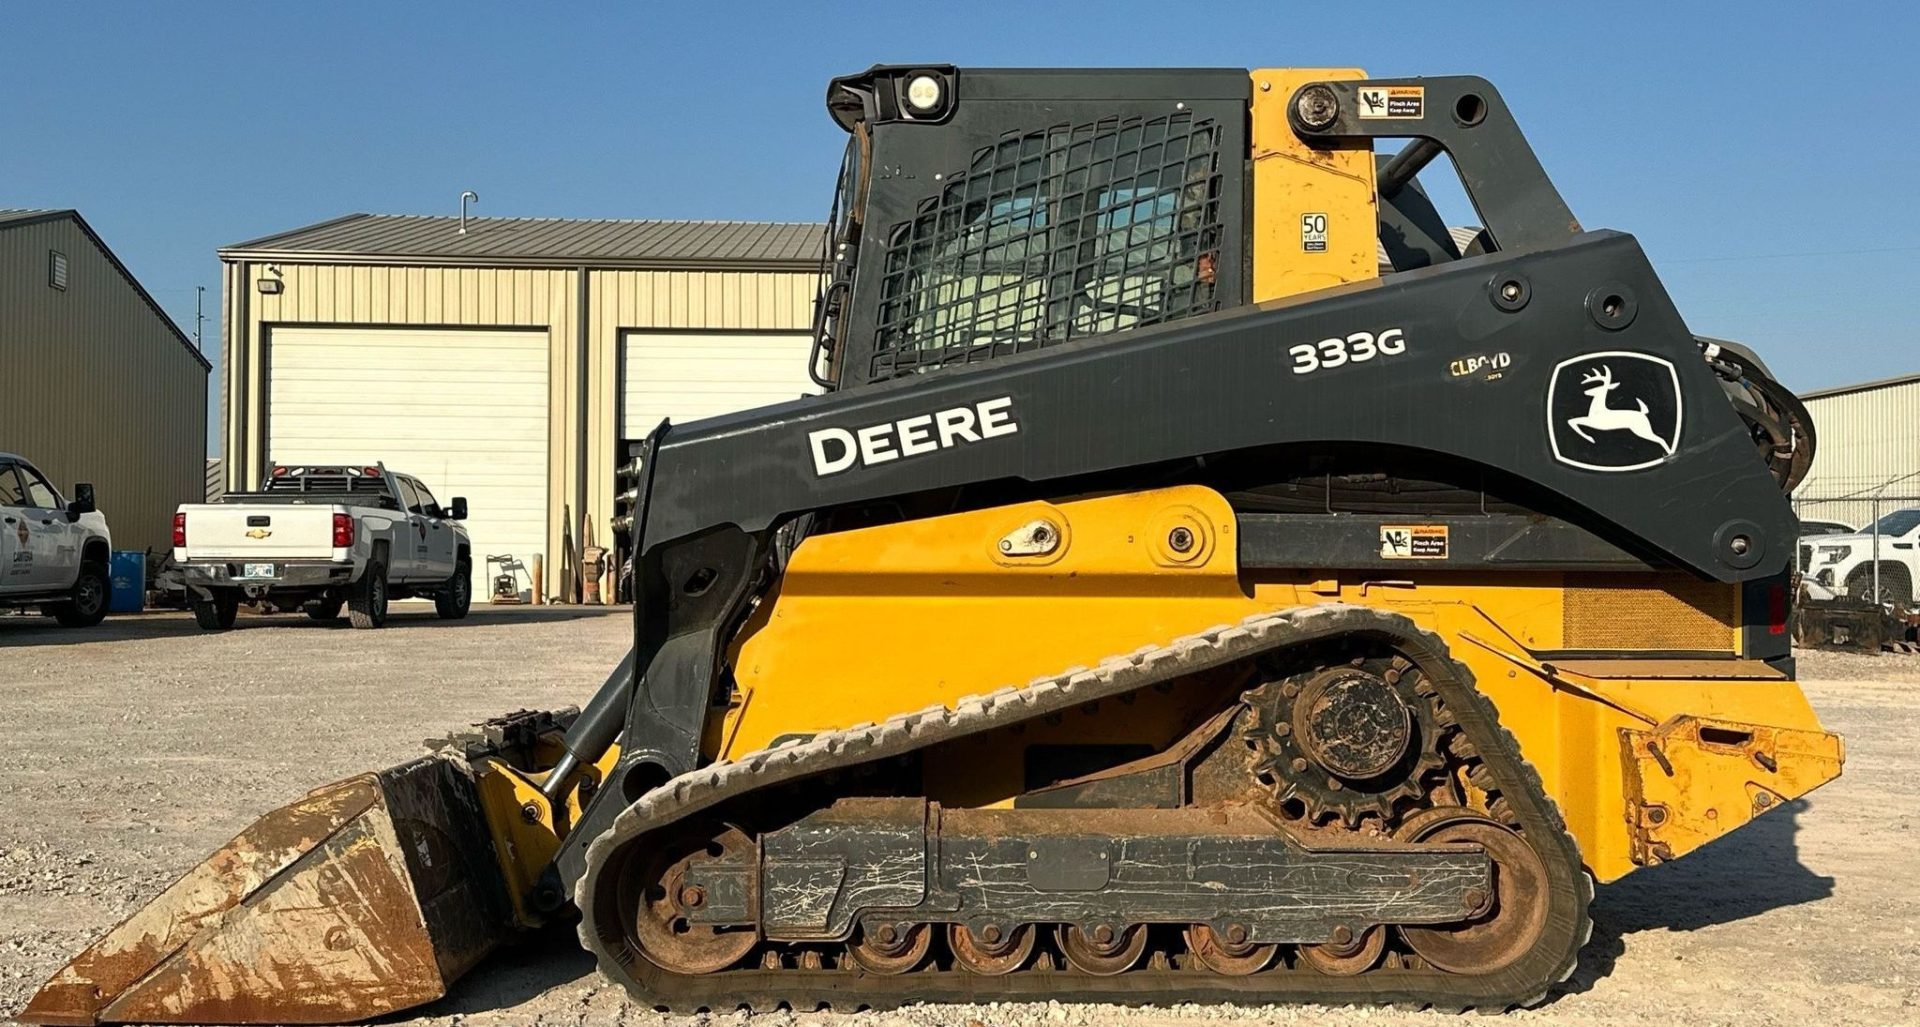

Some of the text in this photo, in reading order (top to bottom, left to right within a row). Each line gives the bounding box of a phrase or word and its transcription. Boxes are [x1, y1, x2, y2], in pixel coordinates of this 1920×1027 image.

[1303, 215, 1326, 234] 50
[1289, 328, 1406, 374] 333G
[808, 396, 1018, 476] DEERE
